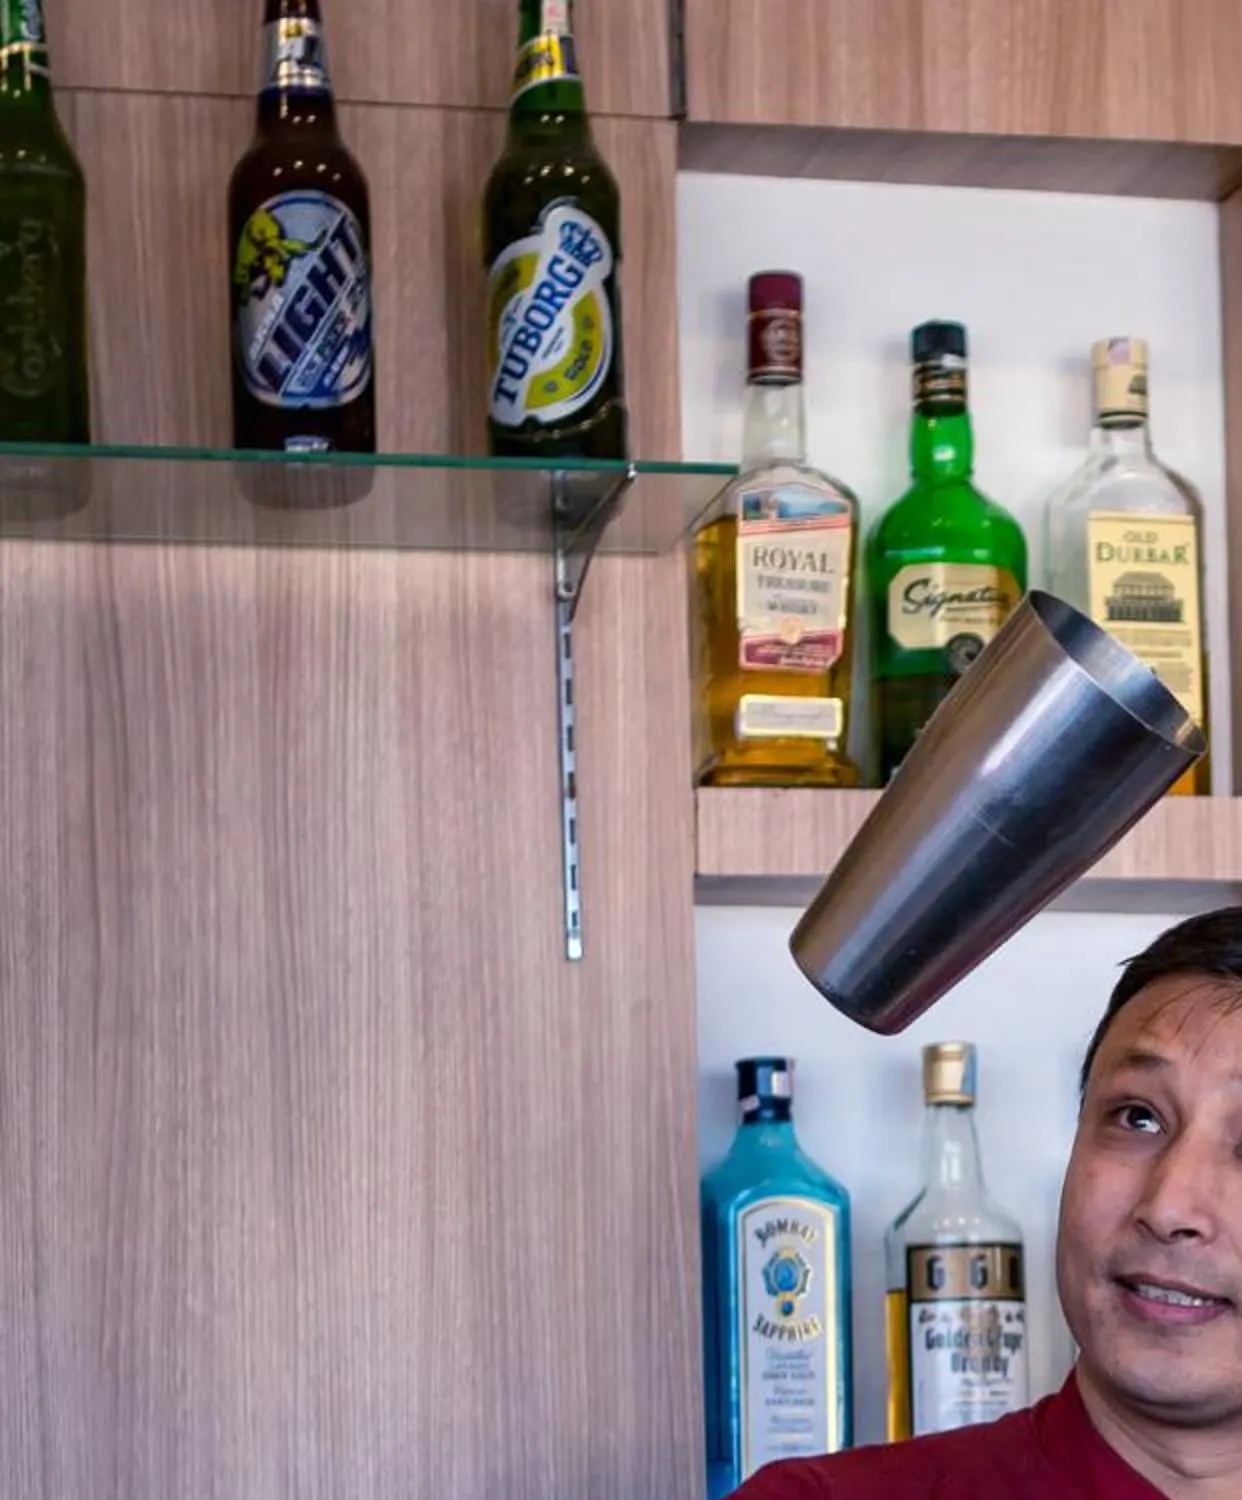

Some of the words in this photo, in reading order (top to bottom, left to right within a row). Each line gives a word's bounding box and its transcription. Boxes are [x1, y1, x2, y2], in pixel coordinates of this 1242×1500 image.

[256, 213, 358, 393] LIGHT
[494, 256, 584, 406] TUBORG
[1123, 530, 1159, 544] OLD
[752, 546, 835, 574] ROYAL
[1096, 541, 1191, 565] DURBAR
[754, 1218, 816, 1245] BOMBAY
[753, 1313, 823, 1342] SAPPHIRE
